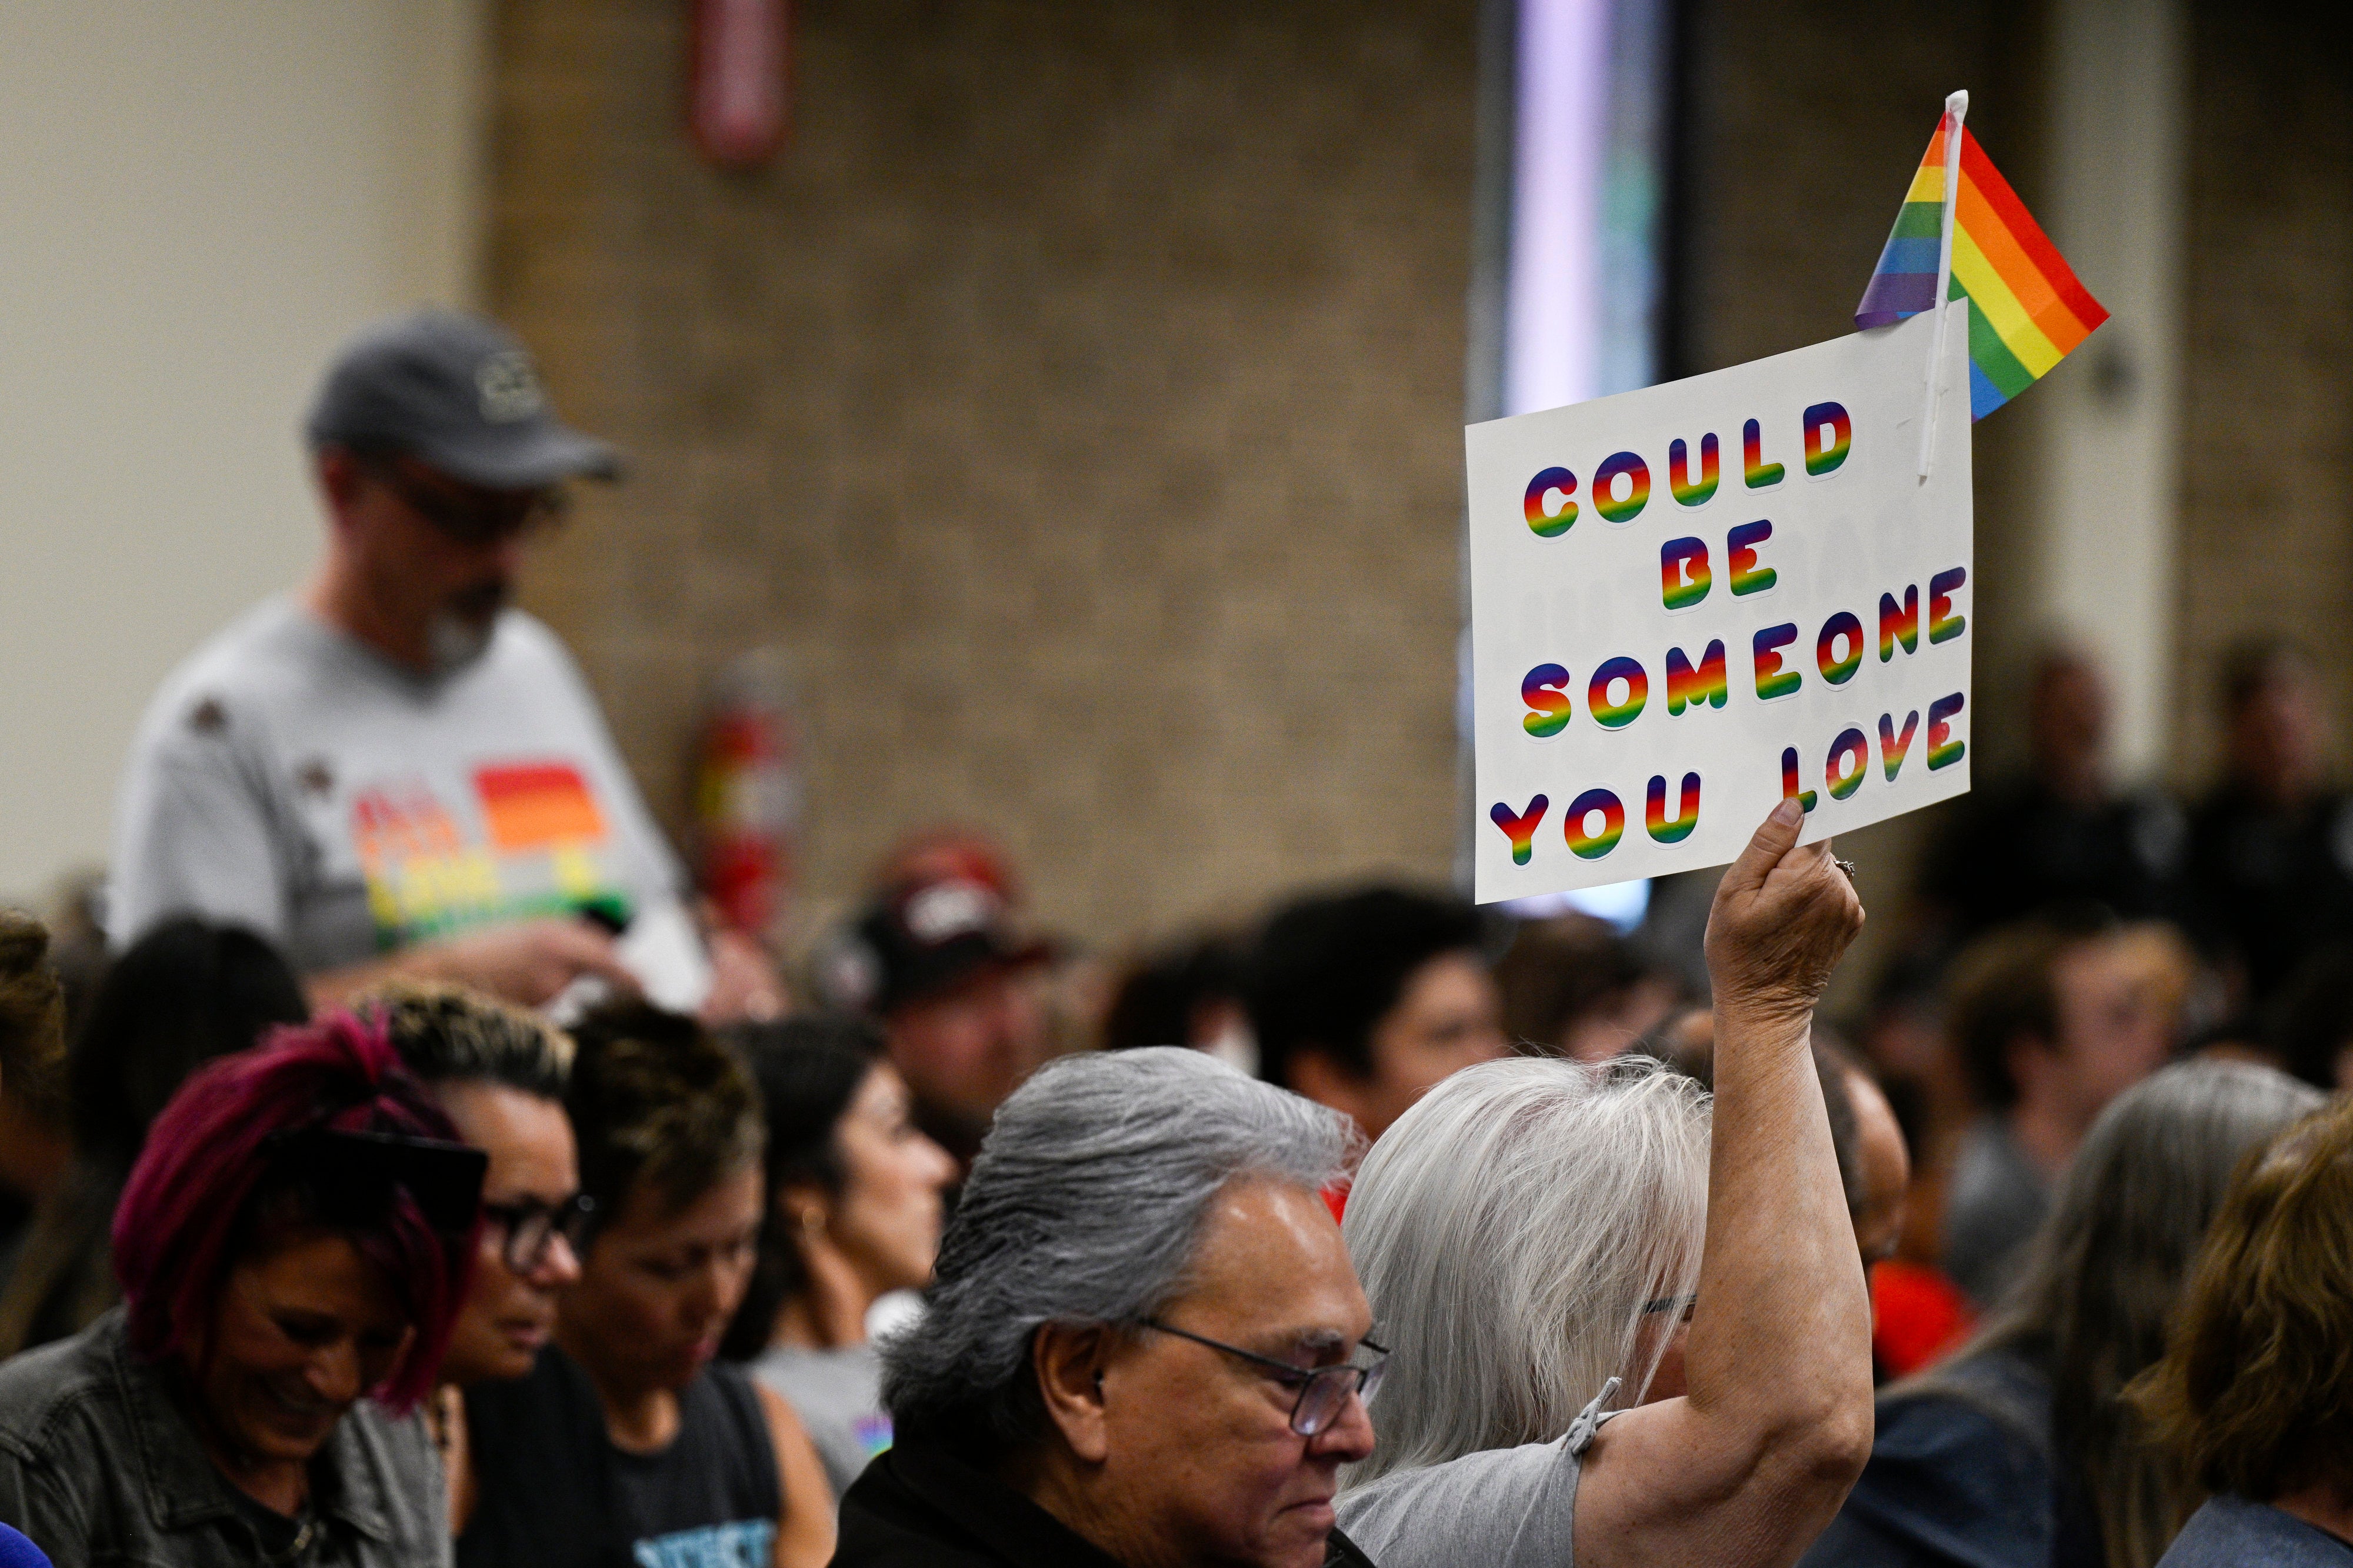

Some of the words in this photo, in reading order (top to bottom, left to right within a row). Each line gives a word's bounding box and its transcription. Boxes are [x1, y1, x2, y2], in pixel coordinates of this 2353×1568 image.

[1524, 401, 1852, 538] COULD
[1660, 519, 1777, 610] BE
[1521, 566, 1967, 738] SOMEONE
[1489, 772, 1702, 866] YOU
[1781, 692, 1965, 814] LOVE
